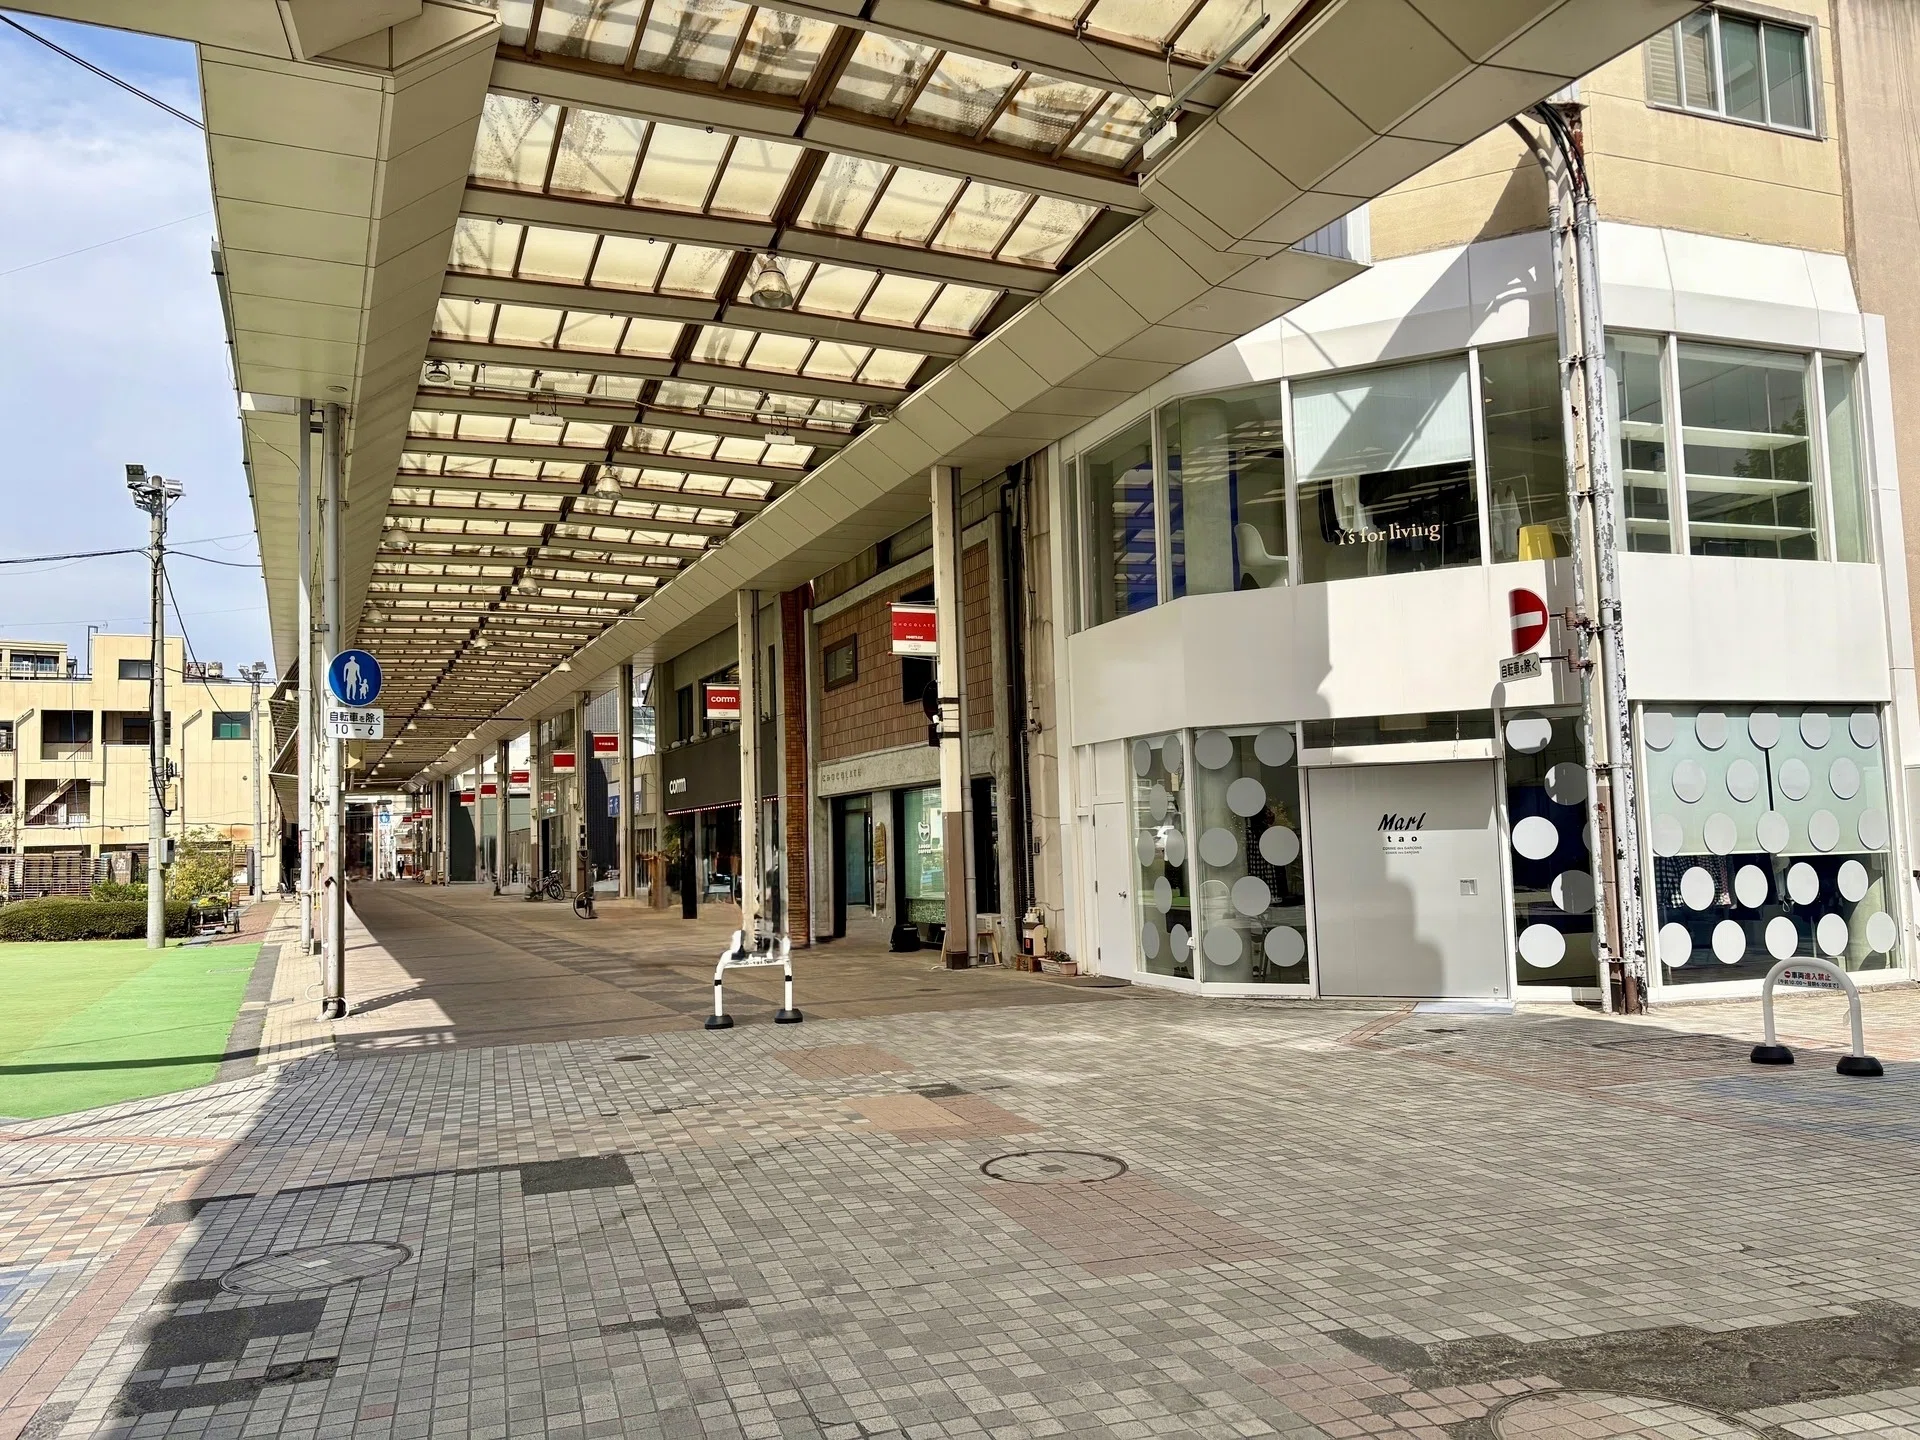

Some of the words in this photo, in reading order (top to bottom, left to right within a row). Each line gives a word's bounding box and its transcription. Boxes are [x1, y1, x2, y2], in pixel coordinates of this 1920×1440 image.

[1359, 527, 1387, 543] for
[1390, 523, 1441, 542] living
[1501, 659, 1538, 678] 自転車を除く
[330, 711, 381, 723] 自転車を除く
[335, 724, 348, 734] 10
[367, 725, 375, 736] 6
[1791, 972, 1831, 981] 車両進入禁止
